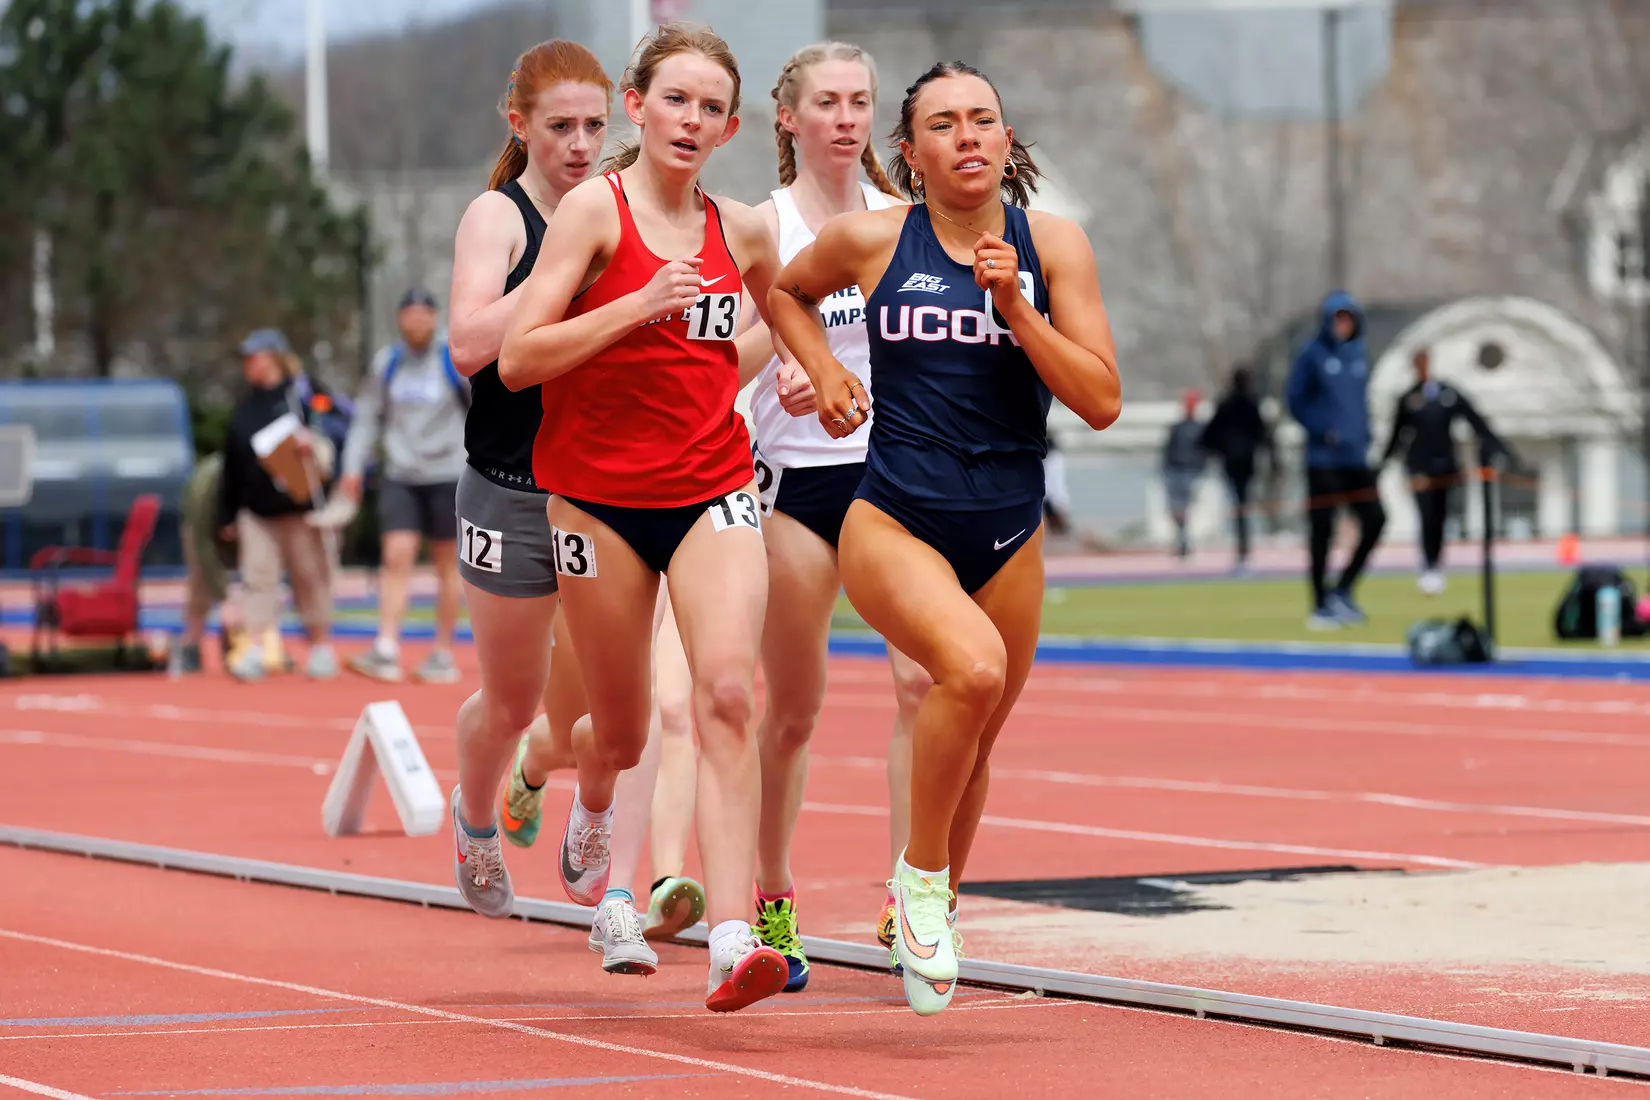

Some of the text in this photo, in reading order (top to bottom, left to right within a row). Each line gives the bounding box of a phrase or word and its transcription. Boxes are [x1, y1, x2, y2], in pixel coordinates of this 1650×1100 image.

[901, 280, 951, 293] EAST
[907, 272, 944, 283] BIG
[696, 295, 736, 339] 13
[880, 305, 1052, 347] UCO
[712, 492, 759, 529] 13
[465, 525, 493, 569] 12
[553, 530, 588, 576] 13
